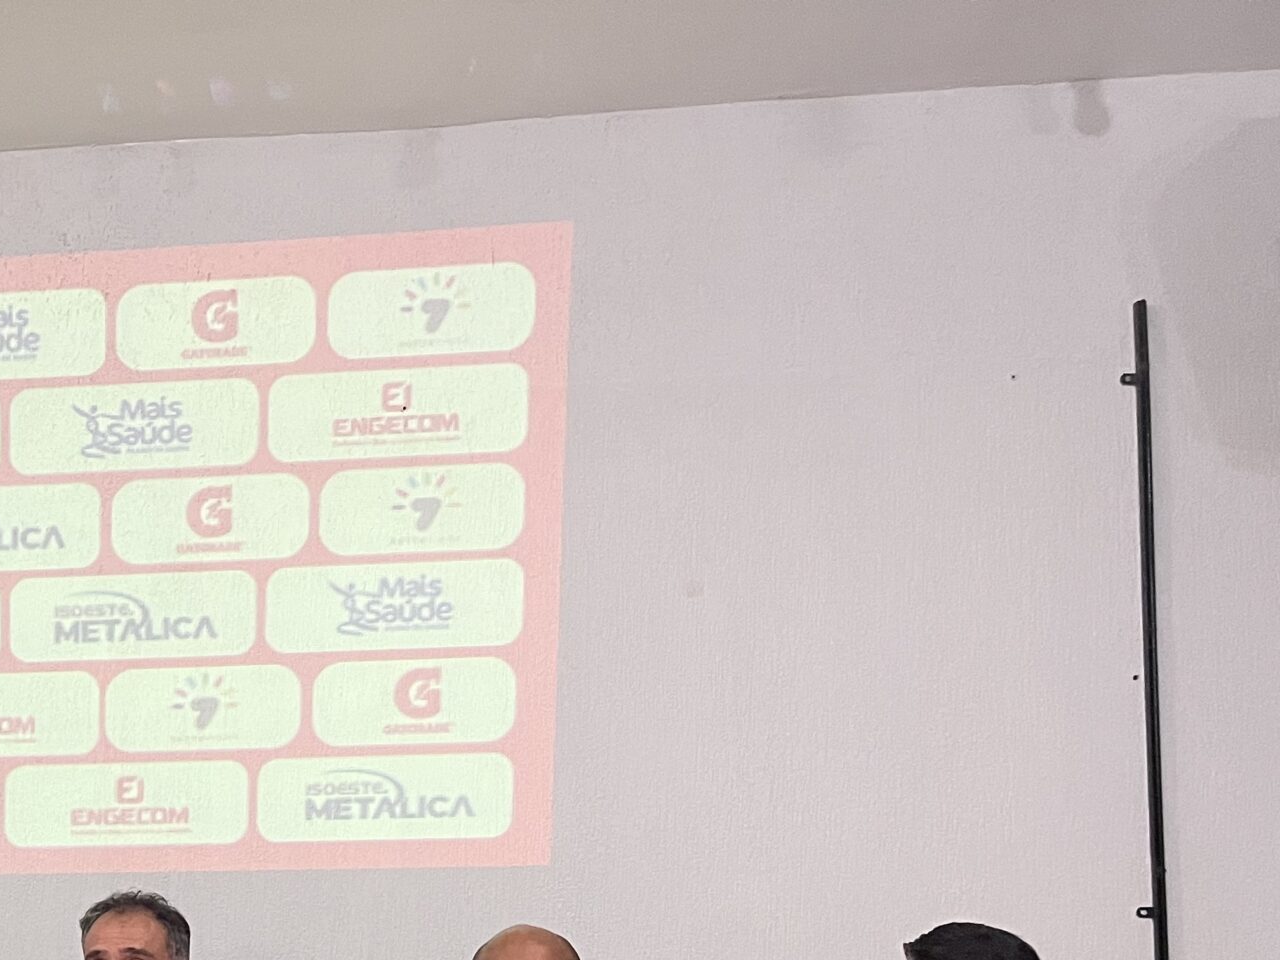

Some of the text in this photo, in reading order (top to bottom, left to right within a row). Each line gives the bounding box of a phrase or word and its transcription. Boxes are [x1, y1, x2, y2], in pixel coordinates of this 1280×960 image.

[120, 396, 183, 420] Mais
[108, 418, 193, 447] Saúde
[332, 411, 459, 437] ENGECOM
[379, 572, 442, 598] Mais
[364, 596, 454, 624] Saúde
[70, 805, 190, 827] ENGECOM
